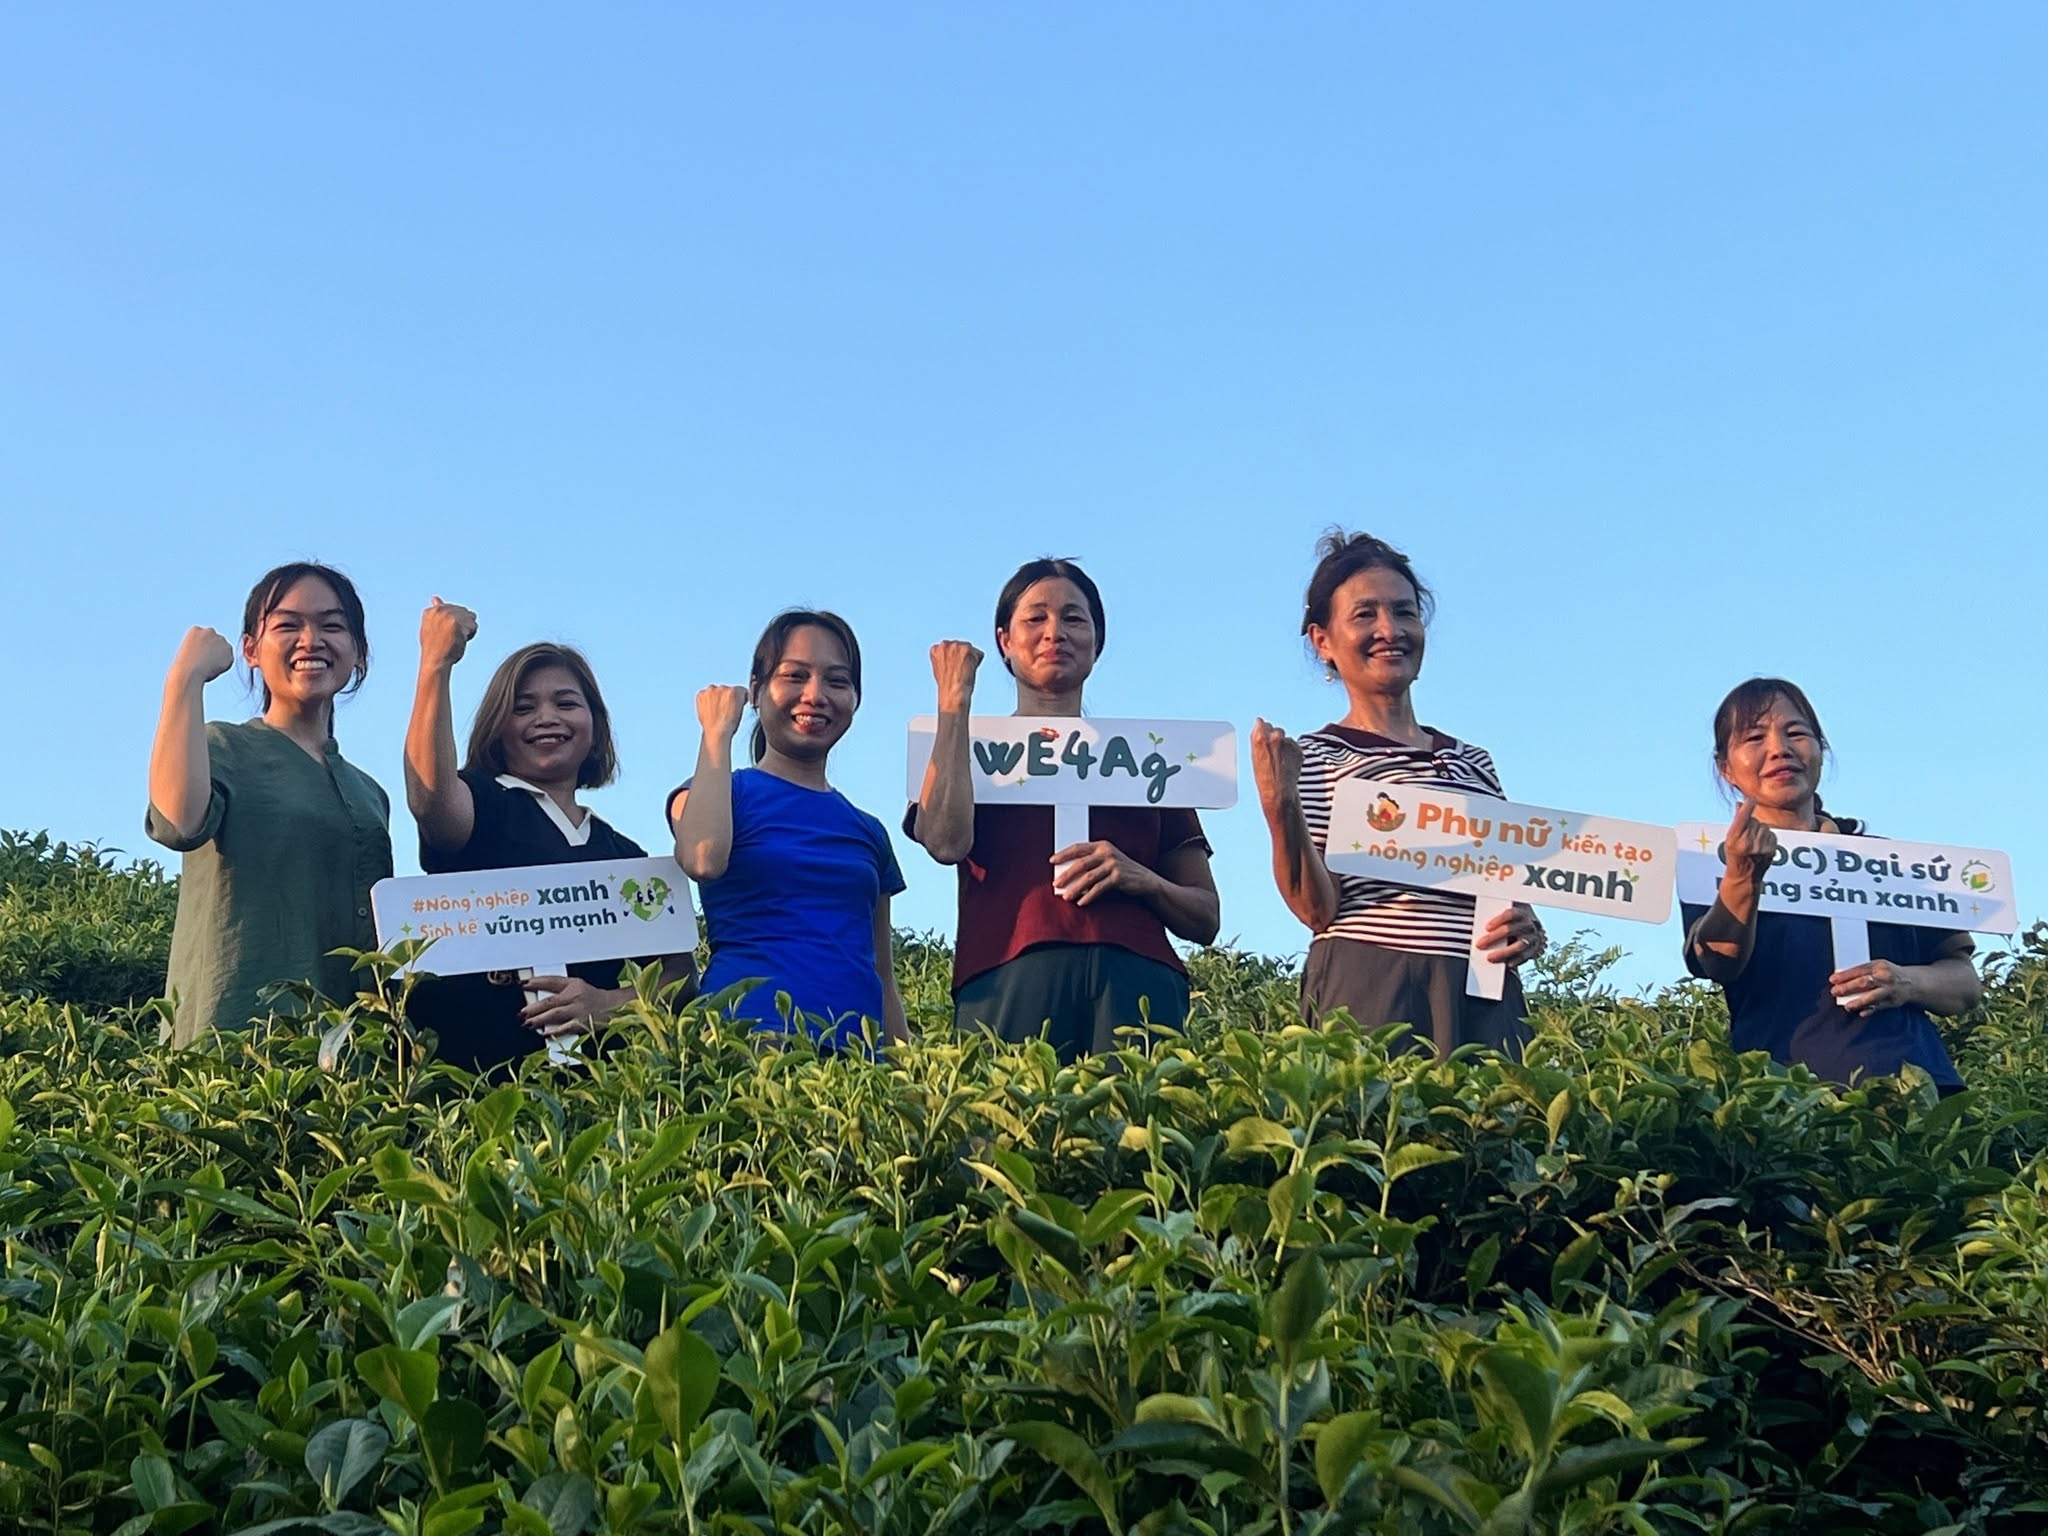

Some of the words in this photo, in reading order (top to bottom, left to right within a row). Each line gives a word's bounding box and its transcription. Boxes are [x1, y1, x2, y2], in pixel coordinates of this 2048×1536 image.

[1417, 803, 1491, 848] Phụ
[1498, 817, 1552, 848] nữ
[1561, 832, 1607, 856] kiến
[1614, 842, 1653, 866] tạo
[1368, 839, 1428, 870] nông
[1434, 853, 1514, 882] nghiệp
[1522, 864, 1633, 903] xanh
[1717, 841, 1827, 876] (OC)
[1834, 849, 1904, 883] Đại
[1910, 854, 1952, 882] sứ
[413, 894, 471, 913] #Nông
[475, 888, 530, 909] nghiệp
[536, 879, 610, 906] xanh
[1809, 878, 1868, 905] sản
[1875, 892, 1960, 914] xanh
[420, 921, 454, 938] Sinh
[458, 917, 479, 935] kế
[485, 915, 545, 935] vững
[549, 908, 618, 933] mạnh
